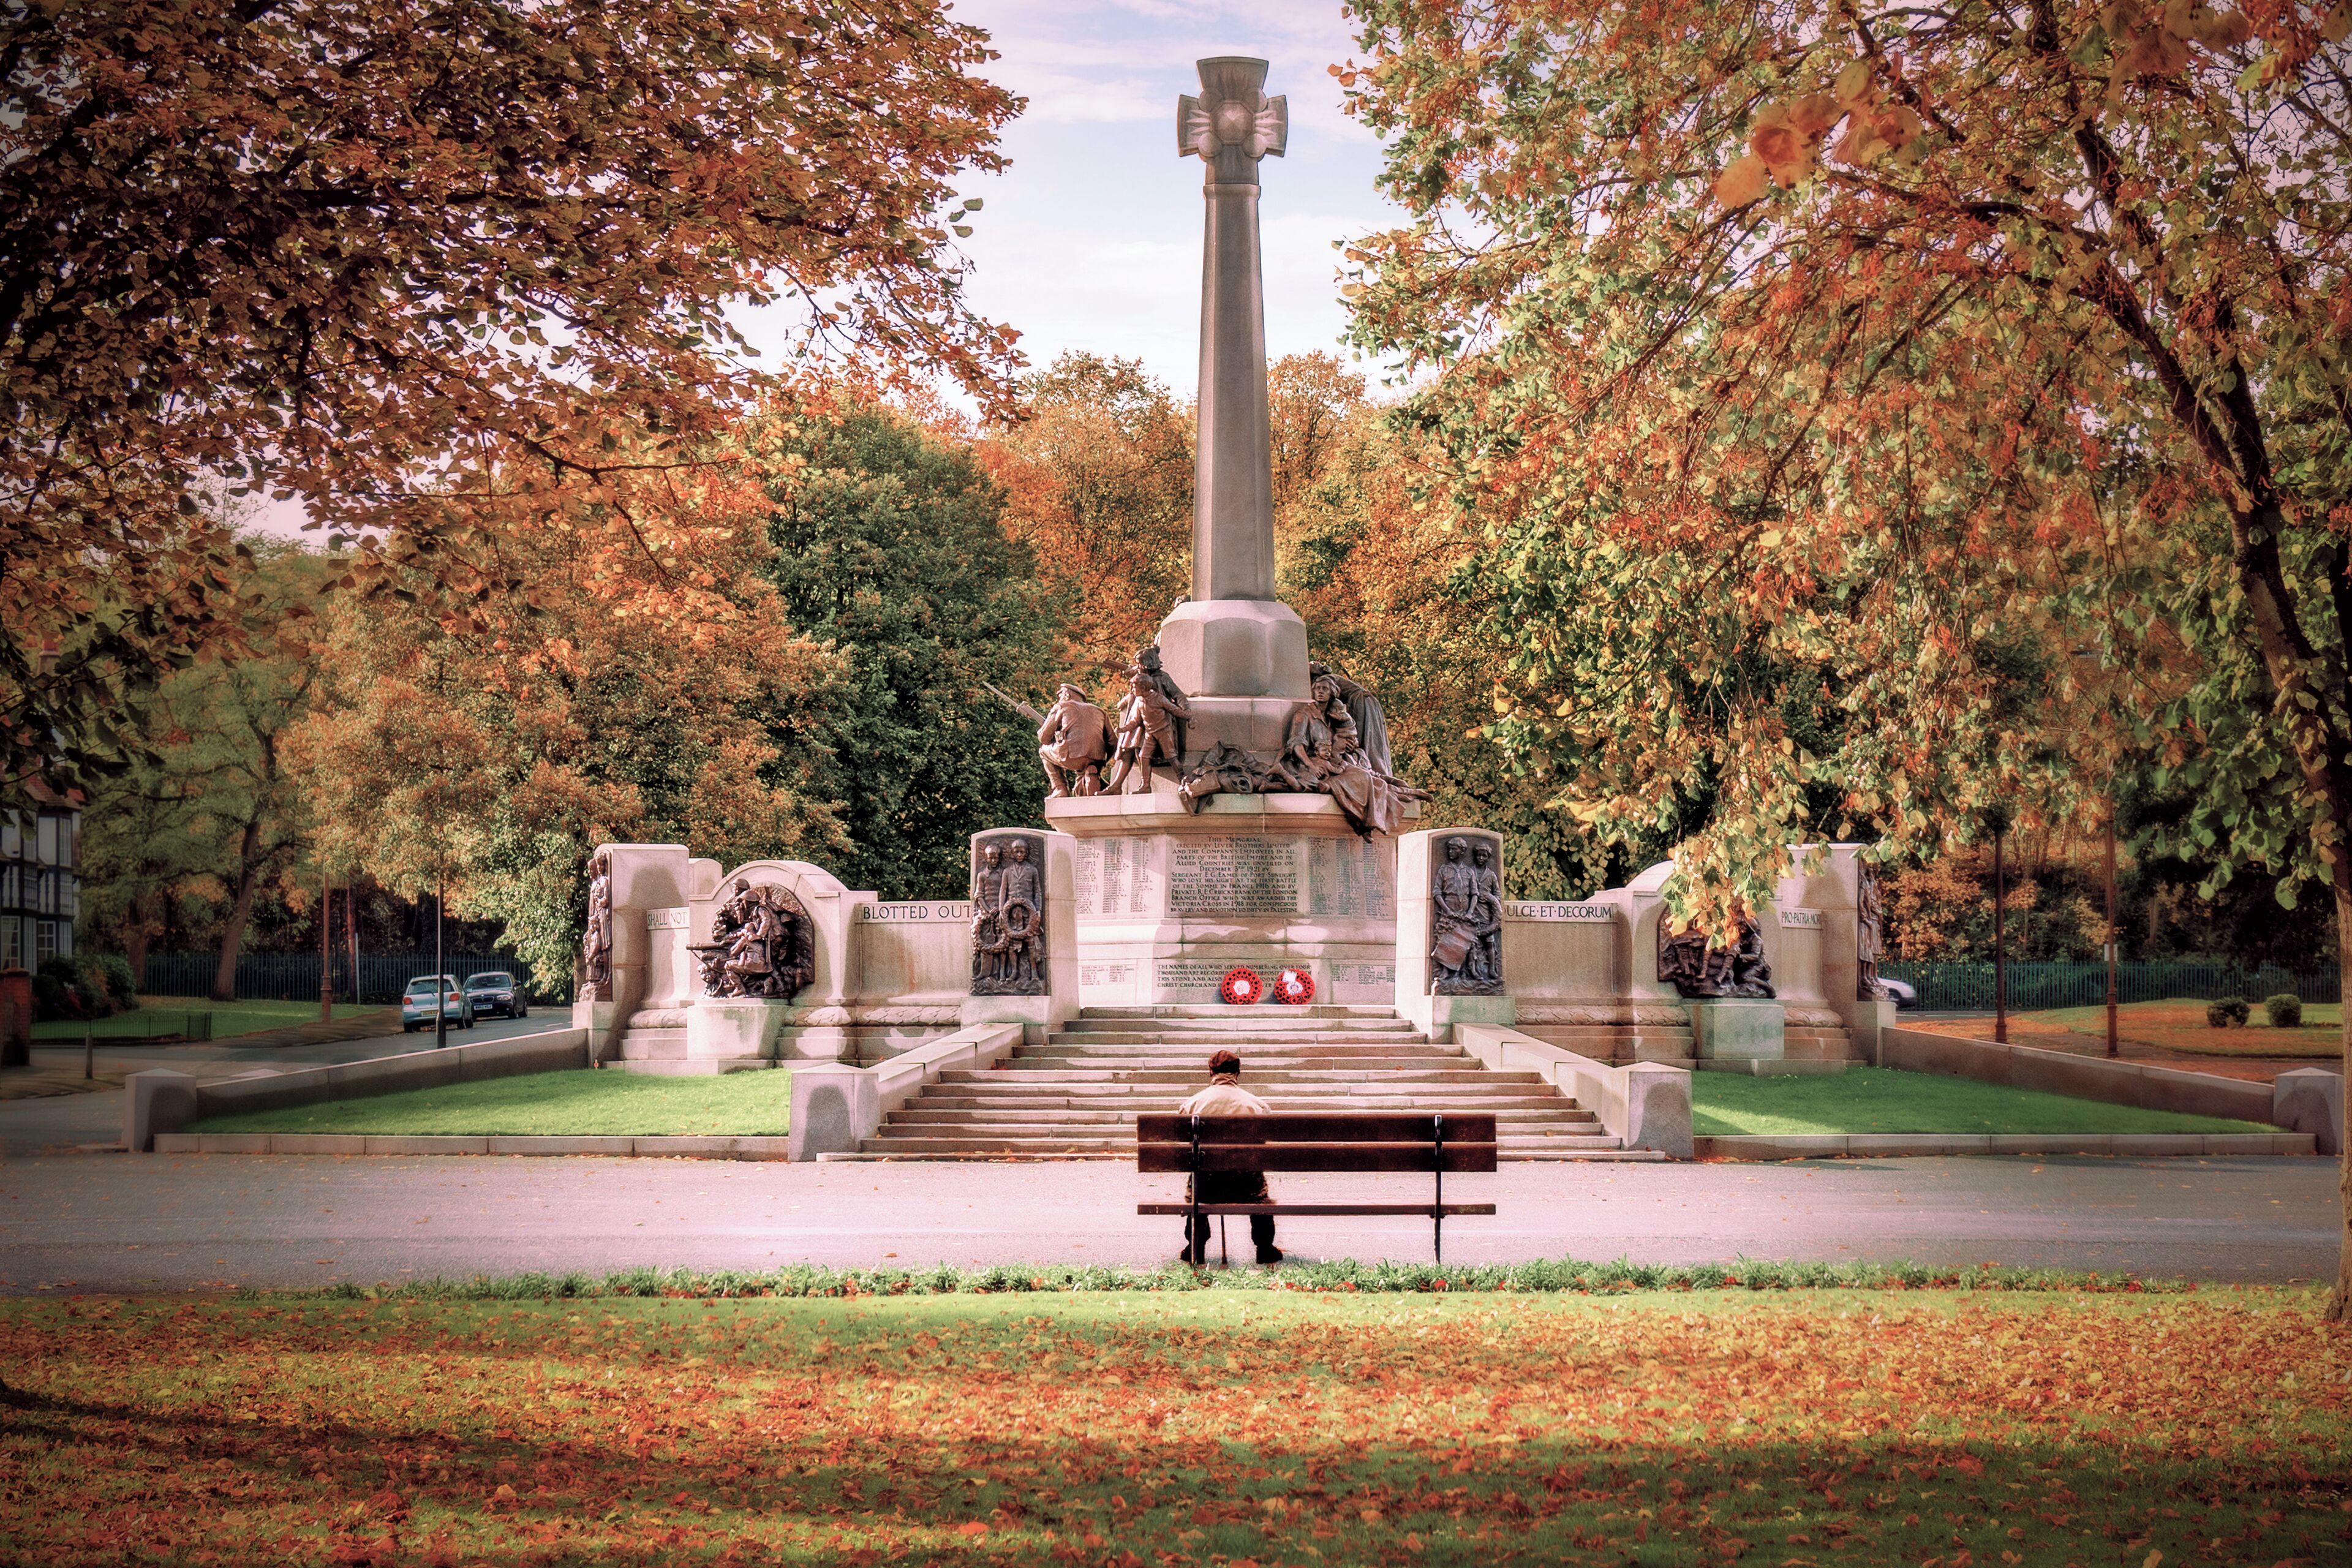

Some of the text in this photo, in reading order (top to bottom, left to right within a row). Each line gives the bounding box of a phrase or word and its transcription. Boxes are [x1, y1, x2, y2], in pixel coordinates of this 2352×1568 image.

[863, 905, 971, 919] BLOTTED OUT
[1504, 905, 1536, 918] ULCE
[647, 913, 668, 927] SHALL
